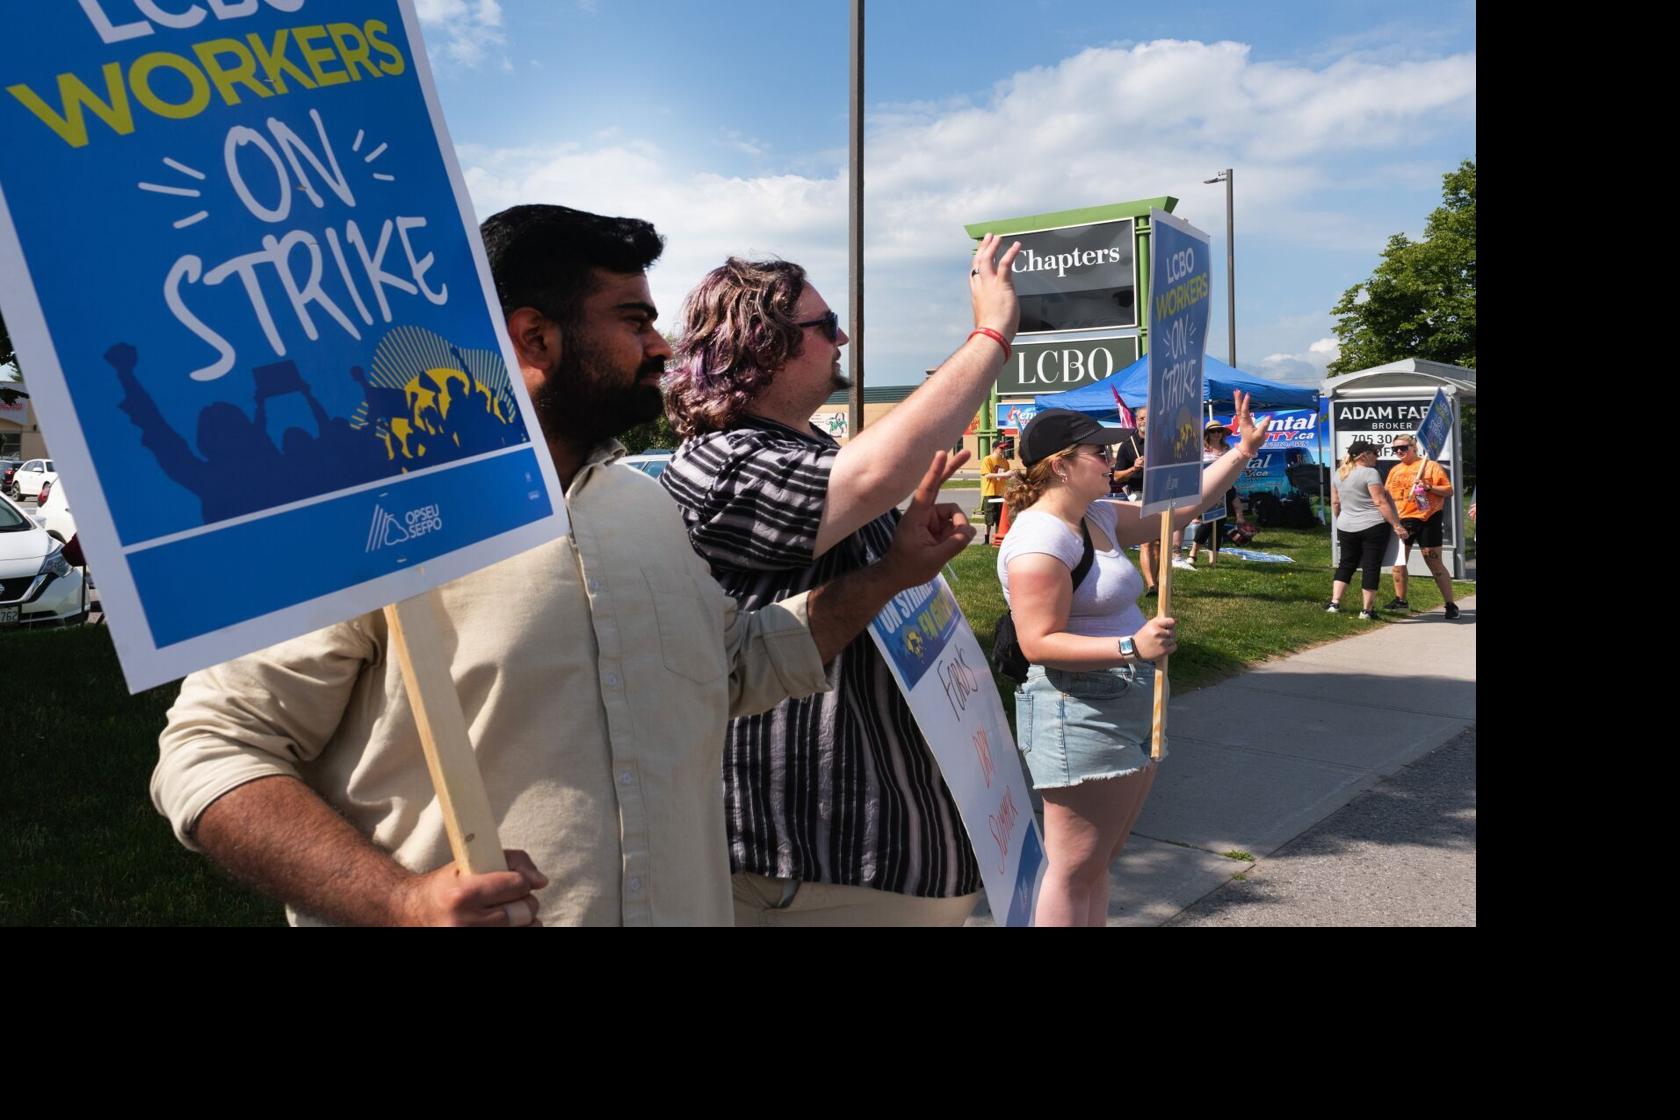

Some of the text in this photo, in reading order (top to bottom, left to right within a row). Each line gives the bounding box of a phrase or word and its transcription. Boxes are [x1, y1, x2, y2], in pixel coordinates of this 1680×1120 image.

[6, 19, 405, 148] WORKERS
[223, 108, 356, 223] ON
[1011, 246, 1120, 278] Chapters
[1166, 247, 1194, 284] LCBO
[163, 216, 448, 381] STRIKE
[1156, 272, 1208, 322] WORKERS
[1171, 314, 1189, 360] ON
[1017, 347, 1114, 384] LCBO
[1159, 359, 1197, 416] STRIKE
[1340, 406, 1392, 420] ADAM
[1371, 422, 1413, 430] BROKER
[405, 504, 440, 525] OPSEU
[409, 517, 442, 538] SEFPO
